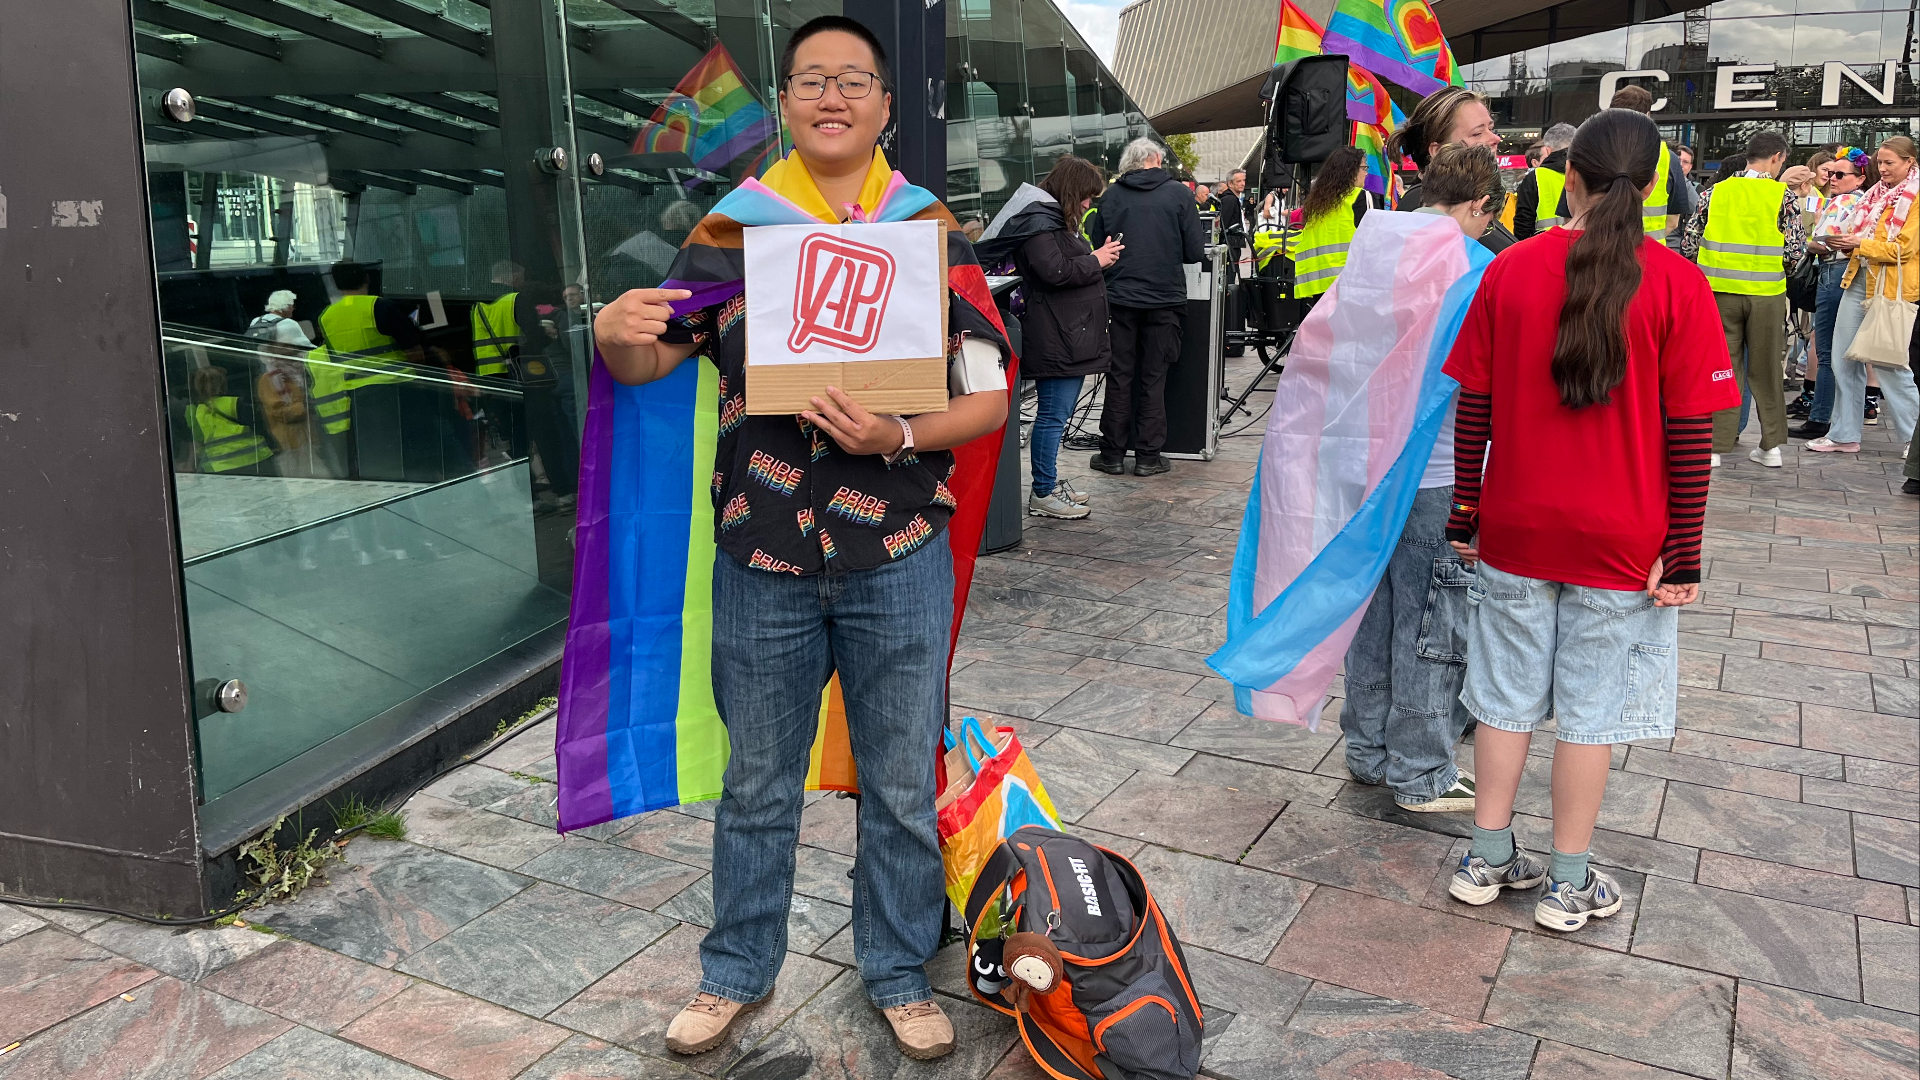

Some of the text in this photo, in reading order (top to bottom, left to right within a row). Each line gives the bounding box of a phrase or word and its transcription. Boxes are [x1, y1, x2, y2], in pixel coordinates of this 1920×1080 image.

[1599, 59, 1897, 112] CEN
[747, 449, 805, 497] PRIDE
[825, 486, 890, 528] PRIDE
[883, 513, 933, 559] PRIDE
